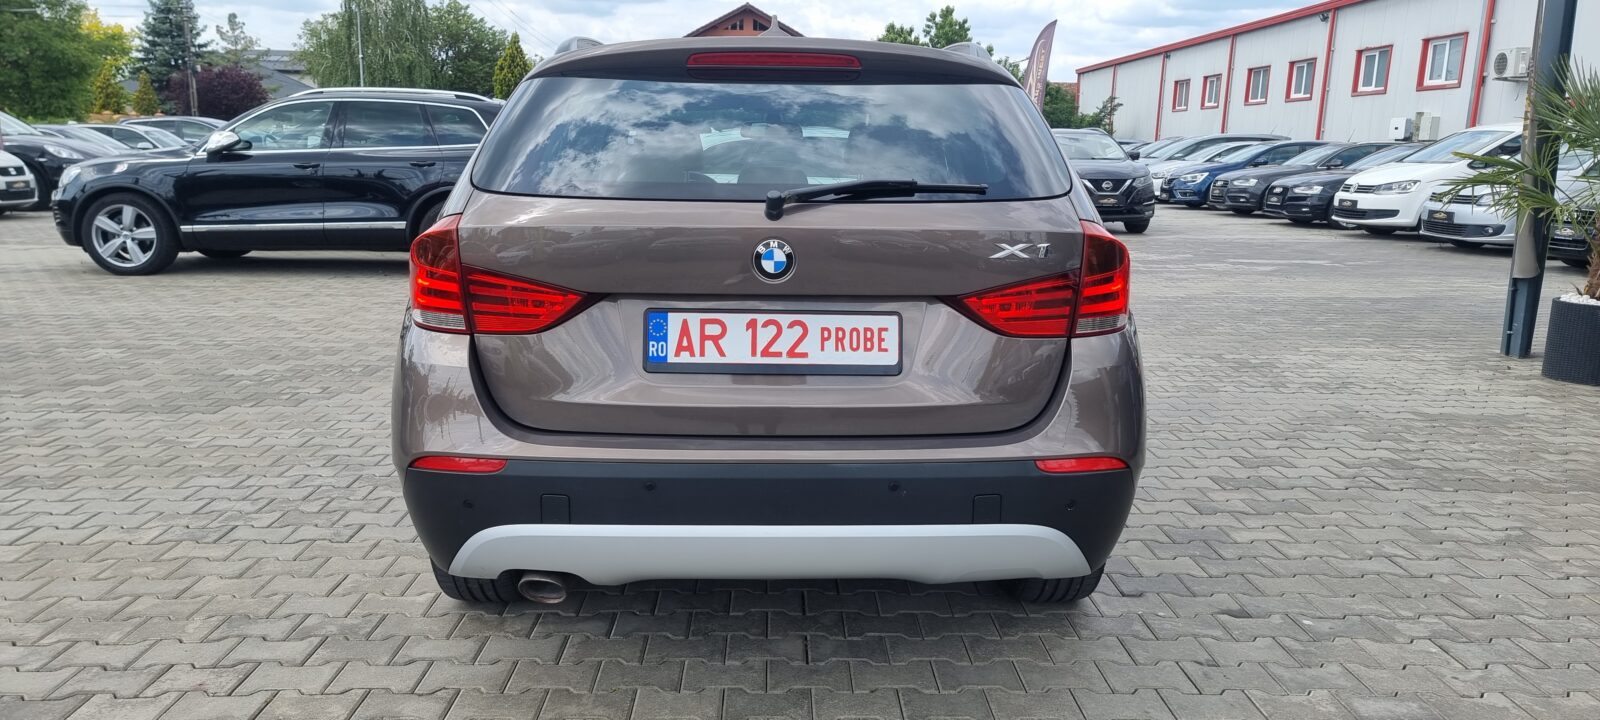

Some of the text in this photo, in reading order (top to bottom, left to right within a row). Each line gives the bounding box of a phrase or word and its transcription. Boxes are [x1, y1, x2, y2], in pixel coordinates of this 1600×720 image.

[757, 240, 792, 254] BMW
[988, 243, 1051, 259] X1
[674, 318, 889, 359] AR 122 PROBE
[648, 341, 667, 357] RO
